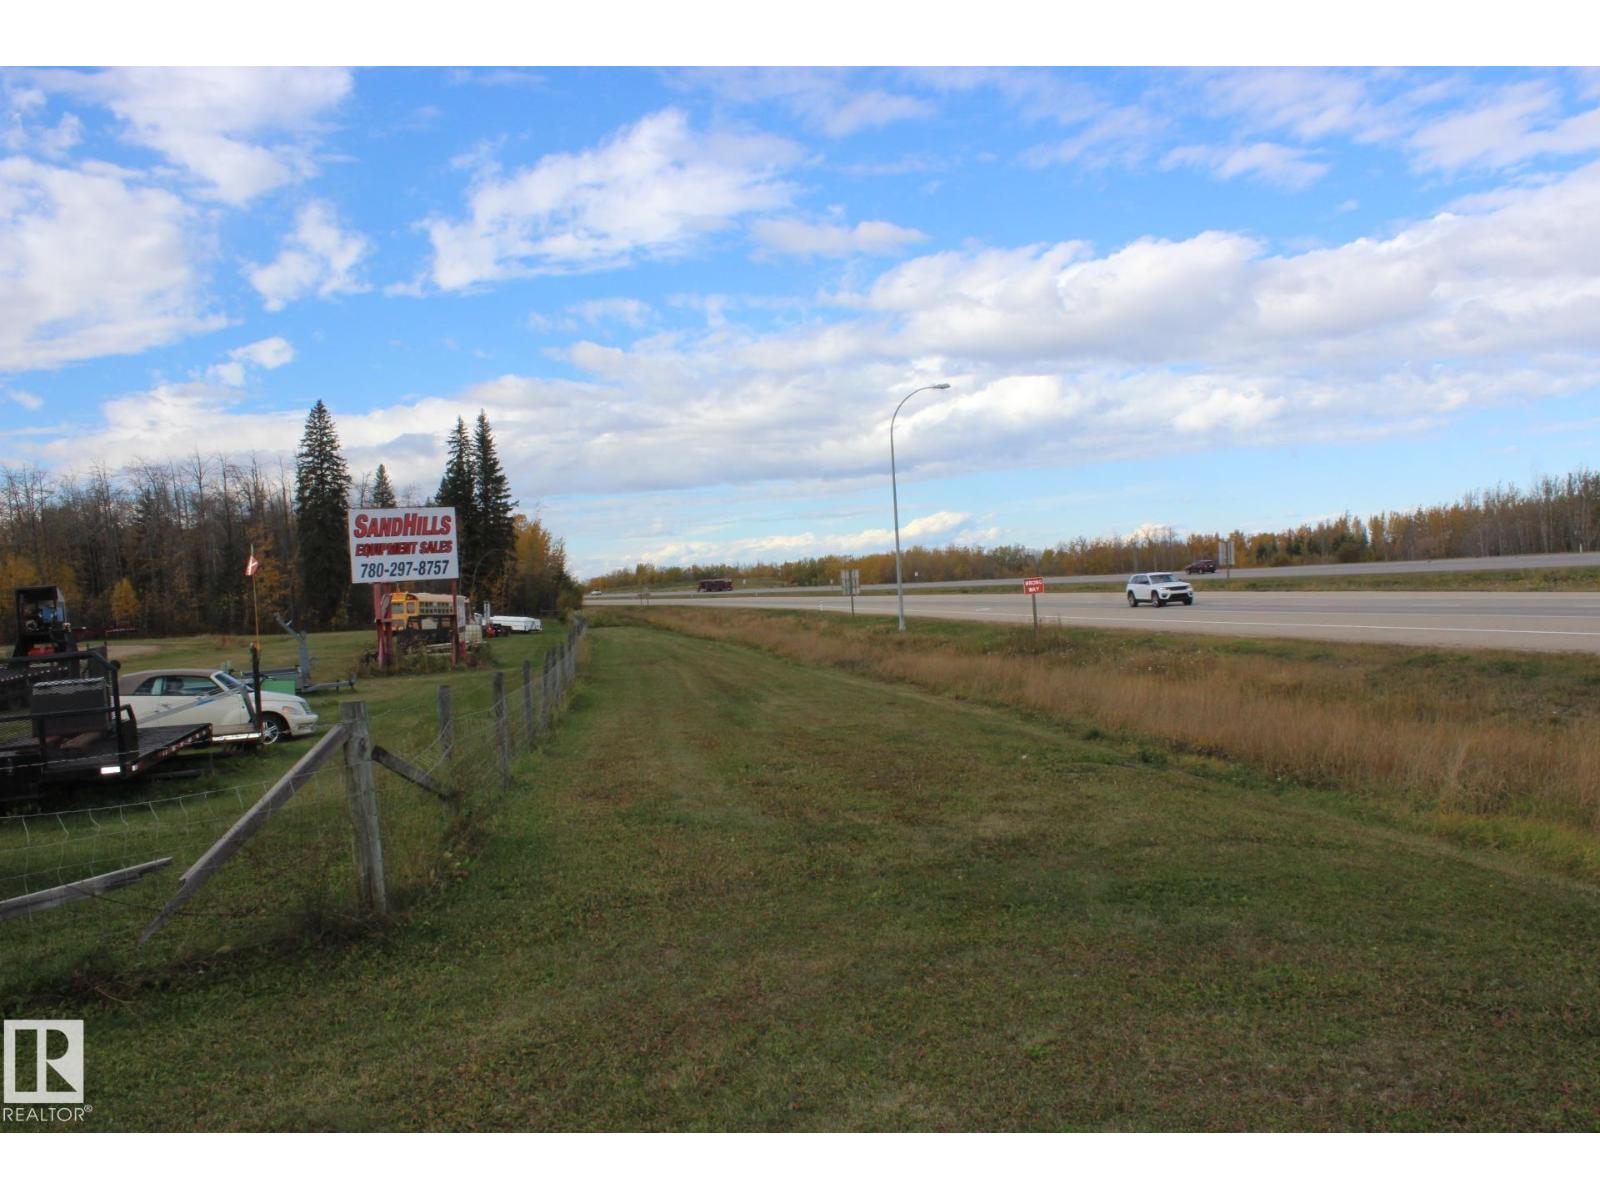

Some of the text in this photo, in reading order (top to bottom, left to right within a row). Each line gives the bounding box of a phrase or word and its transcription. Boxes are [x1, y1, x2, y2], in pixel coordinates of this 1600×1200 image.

[355, 541, 453, 557] EQUIPMENT SALES
[361, 560, 449, 578] 780-297-8757
